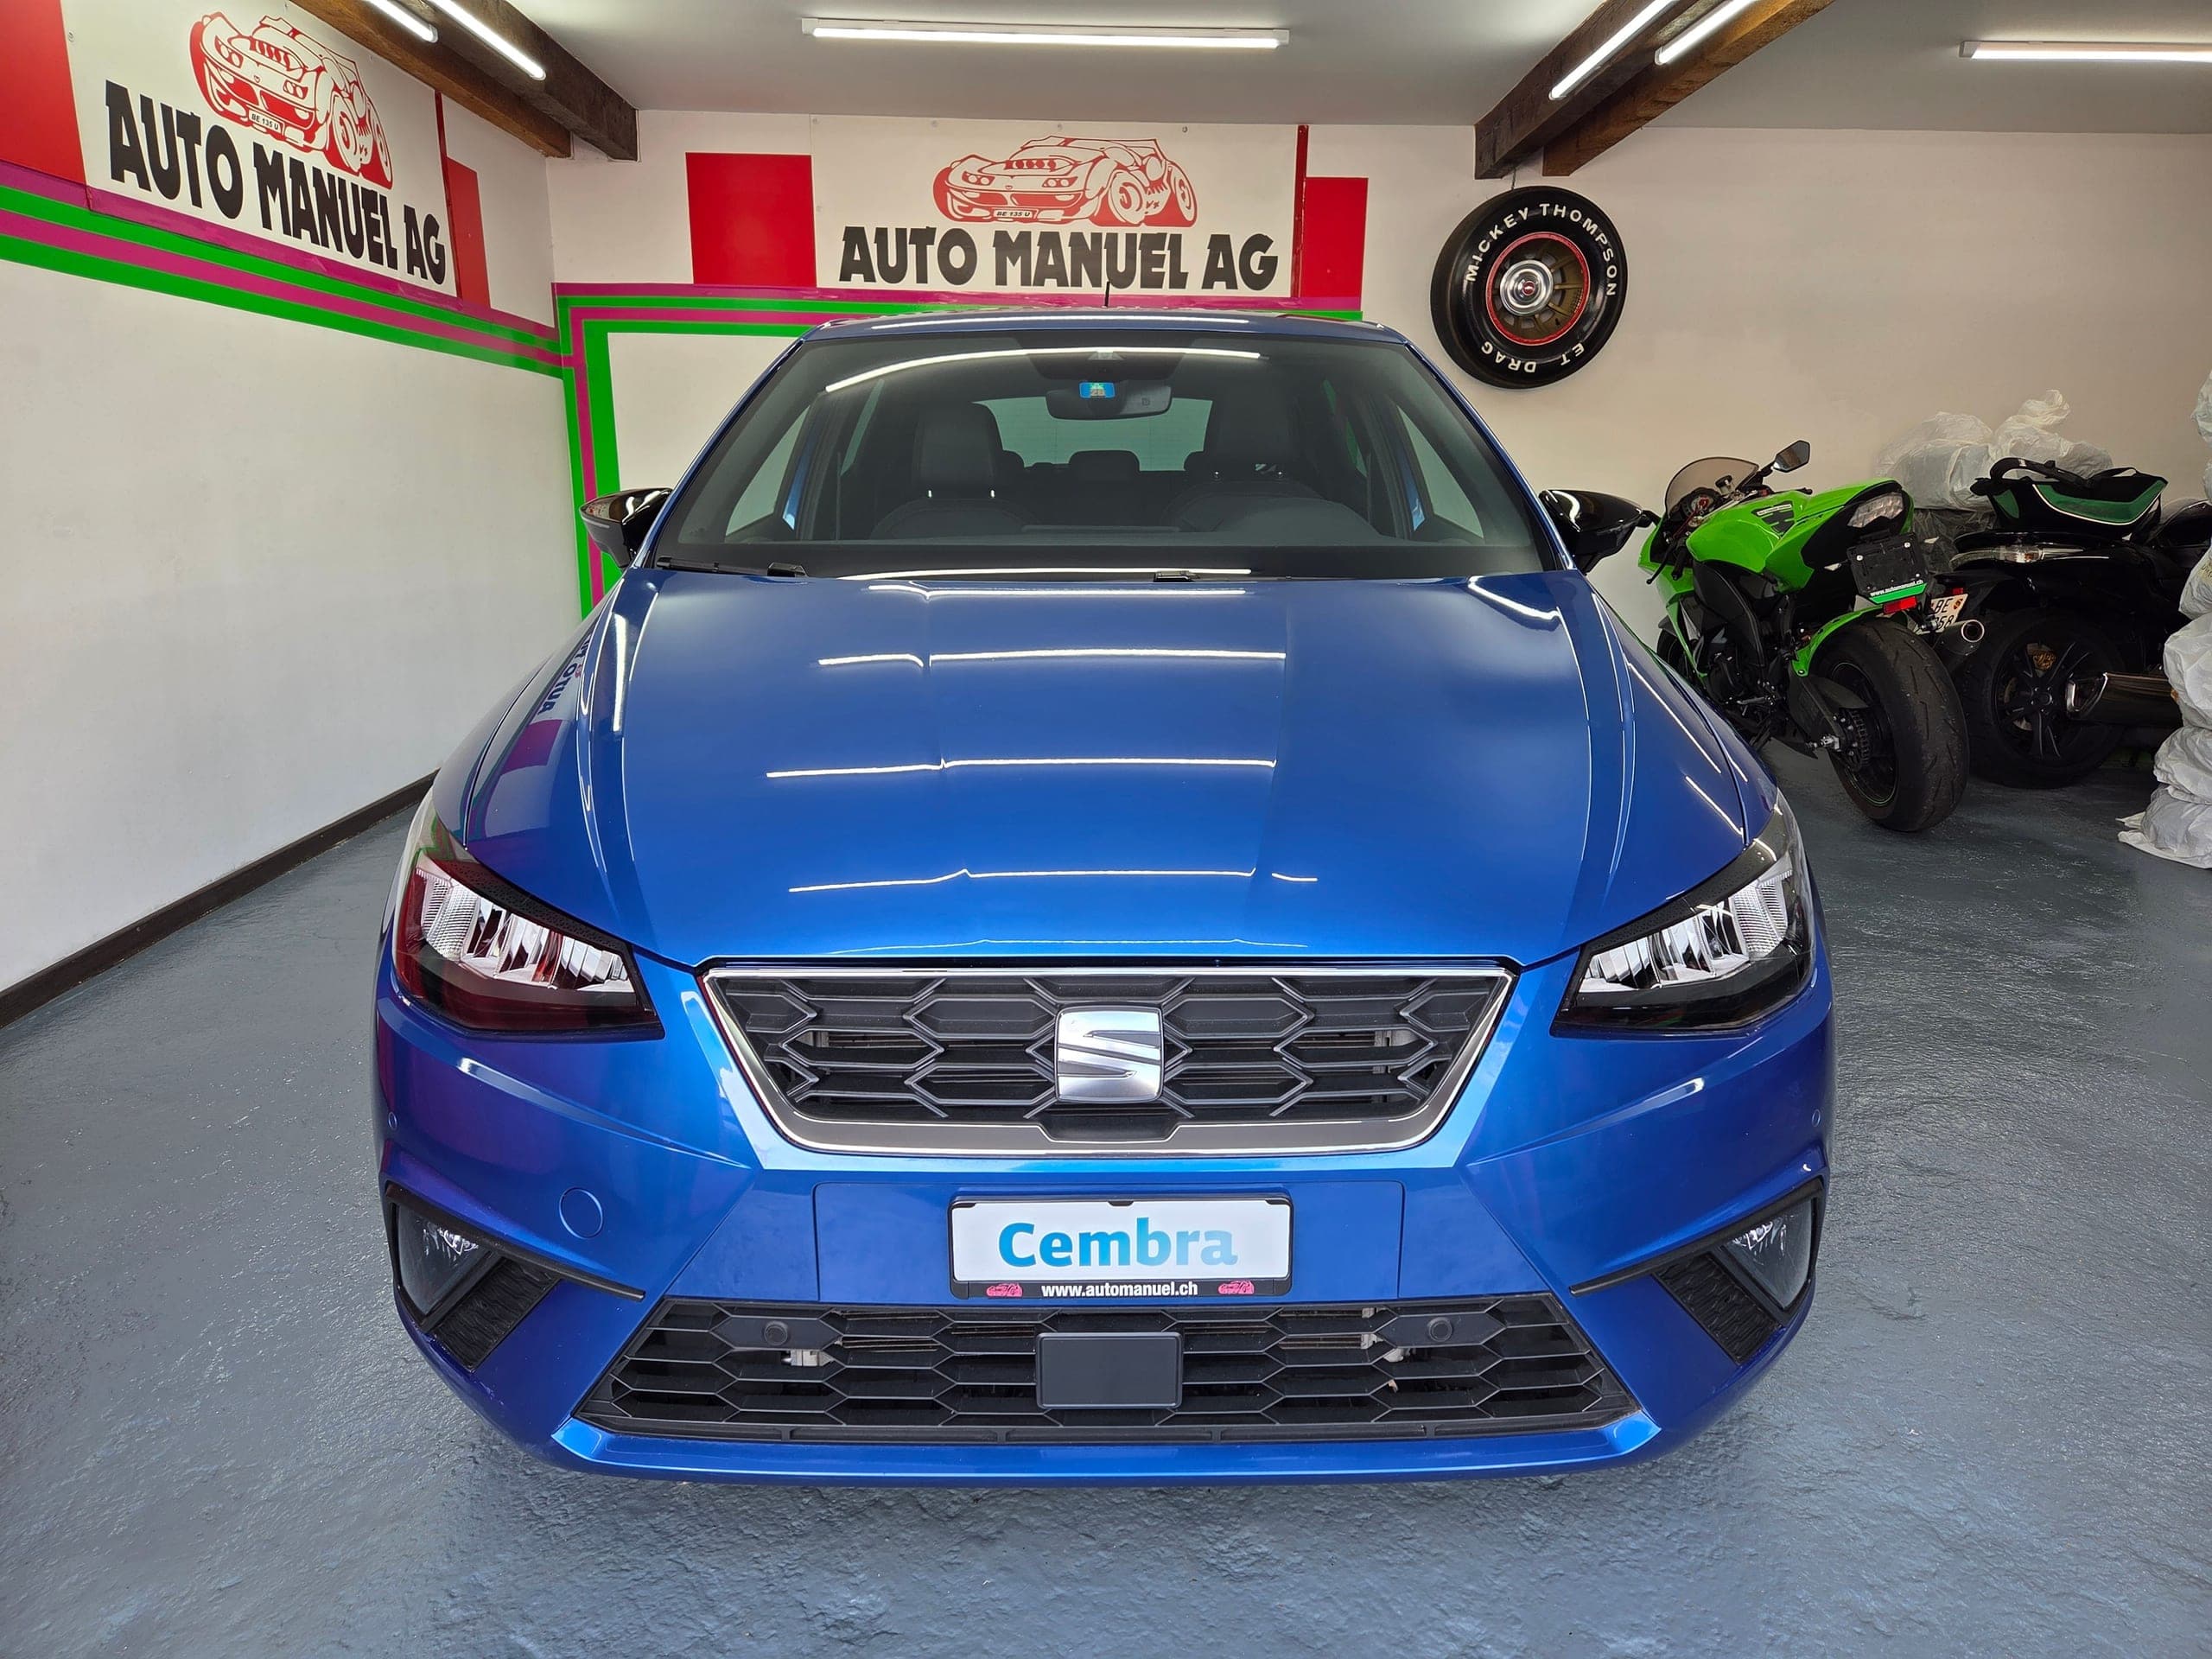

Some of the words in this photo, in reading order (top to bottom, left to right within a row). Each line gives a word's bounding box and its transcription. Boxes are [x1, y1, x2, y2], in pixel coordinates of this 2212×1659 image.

[251, 113, 260, 123] BE
[105, 79, 244, 219] AUTO
[253, 143, 397, 270] MANUEL
[404, 204, 446, 285] AG
[839, 226, 978, 286] AUTO
[993, 230, 1189, 289] MANUEL
[1201, 233, 1278, 291] AG
[1465, 207, 1529, 283] MICKEY
[1539, 203, 1618, 296] THOMPSON
[1481, 341, 1537, 373] DRAG
[1934, 597, 1954, 614] BE
[998, 1217, 1239, 1268] Cembra
[1041, 1281, 1198, 1297] www.automanuel.ch
